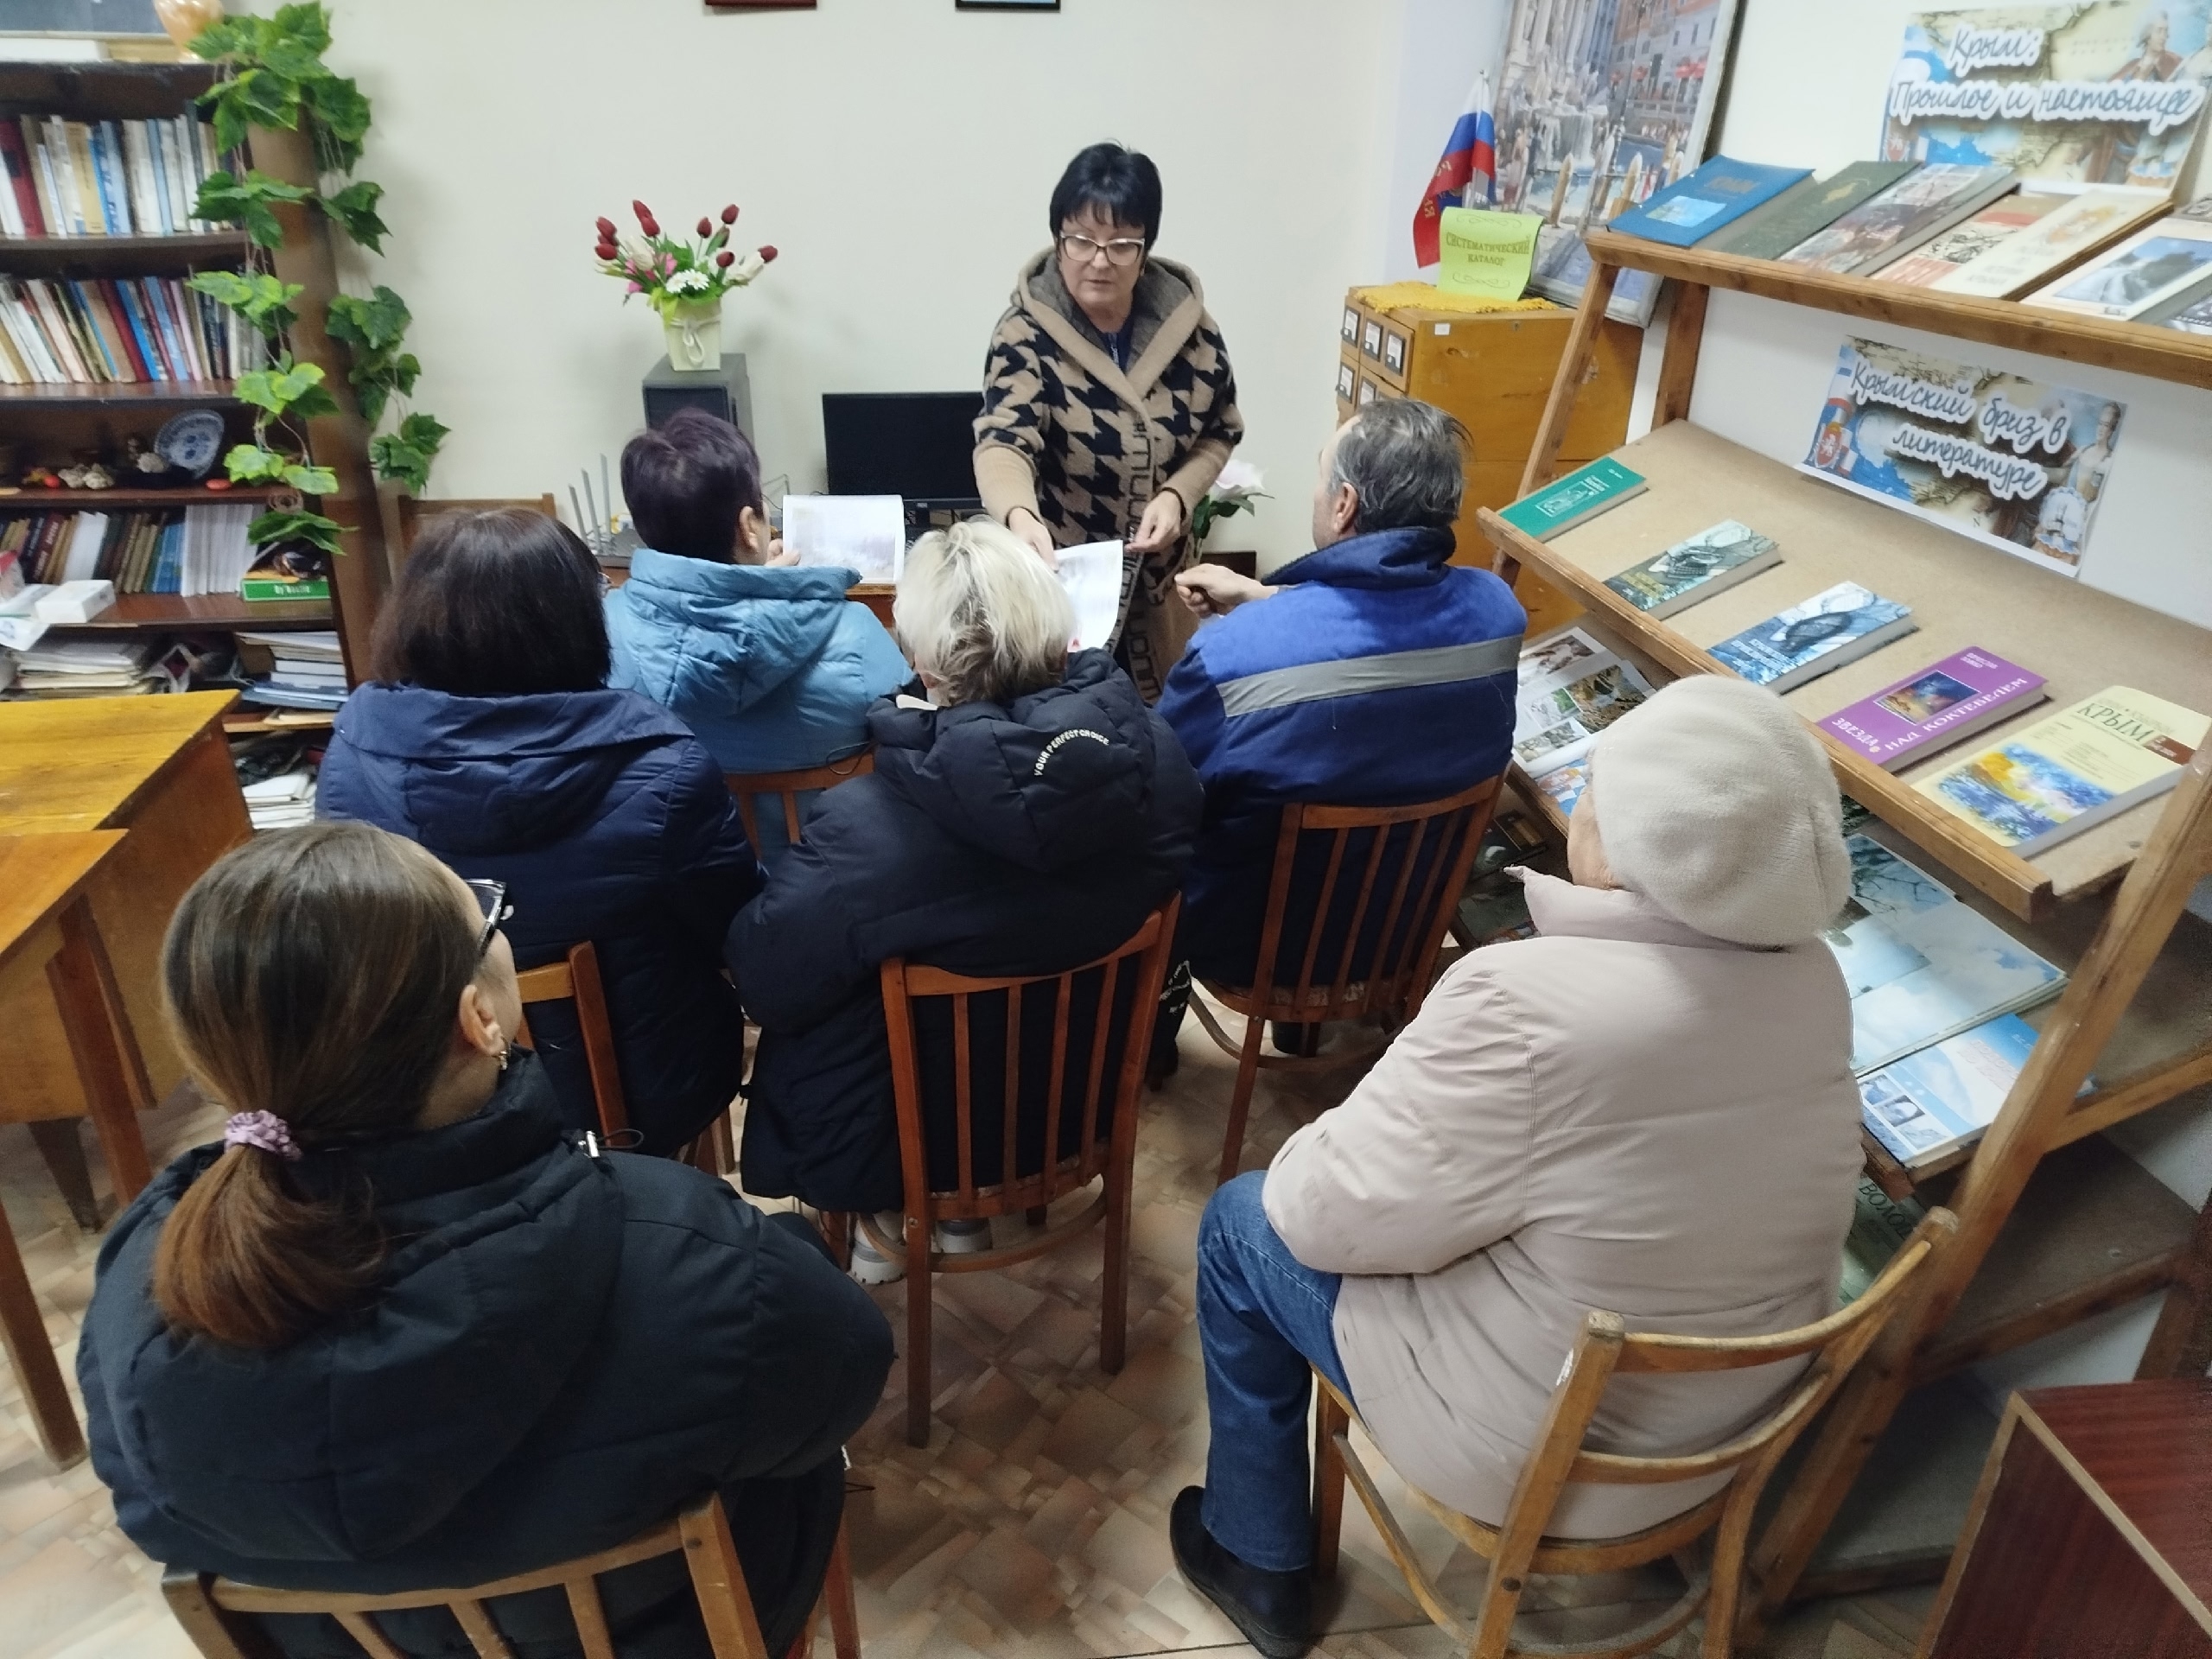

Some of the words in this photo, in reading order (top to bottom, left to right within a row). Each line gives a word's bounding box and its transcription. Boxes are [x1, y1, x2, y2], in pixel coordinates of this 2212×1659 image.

[1950, 27, 2037, 67] Крым:
[1893, 80, 1997, 113] Прошлое
[2005, 88, 2032, 111] и
[2037, 87, 2196, 122] настоящее
[1446, 232, 1531, 255] СИСТЕМАТИЧЕСКИЙ
[1468, 253, 1505, 267] КАТАЛОГ
[1852, 362, 1973, 417] Крымский
[1981, 397, 2044, 444] бриз
[2050, 414, 2068, 446] в
[1892, 428, 2044, 493] литературе
[1832, 717, 1879, 747] ЗВЕЗДА
[1885, 730, 1923, 751] НАД
[1923, 677, 2028, 733] КОКТЕБЕЛЕМ
[2076, 702, 2155, 742] КРЫМ
[1033, 751, 1051, 776] YOUR
[1046, 729, 1079, 753] PERFECT
[1078, 728, 1110, 746] CHOICE
